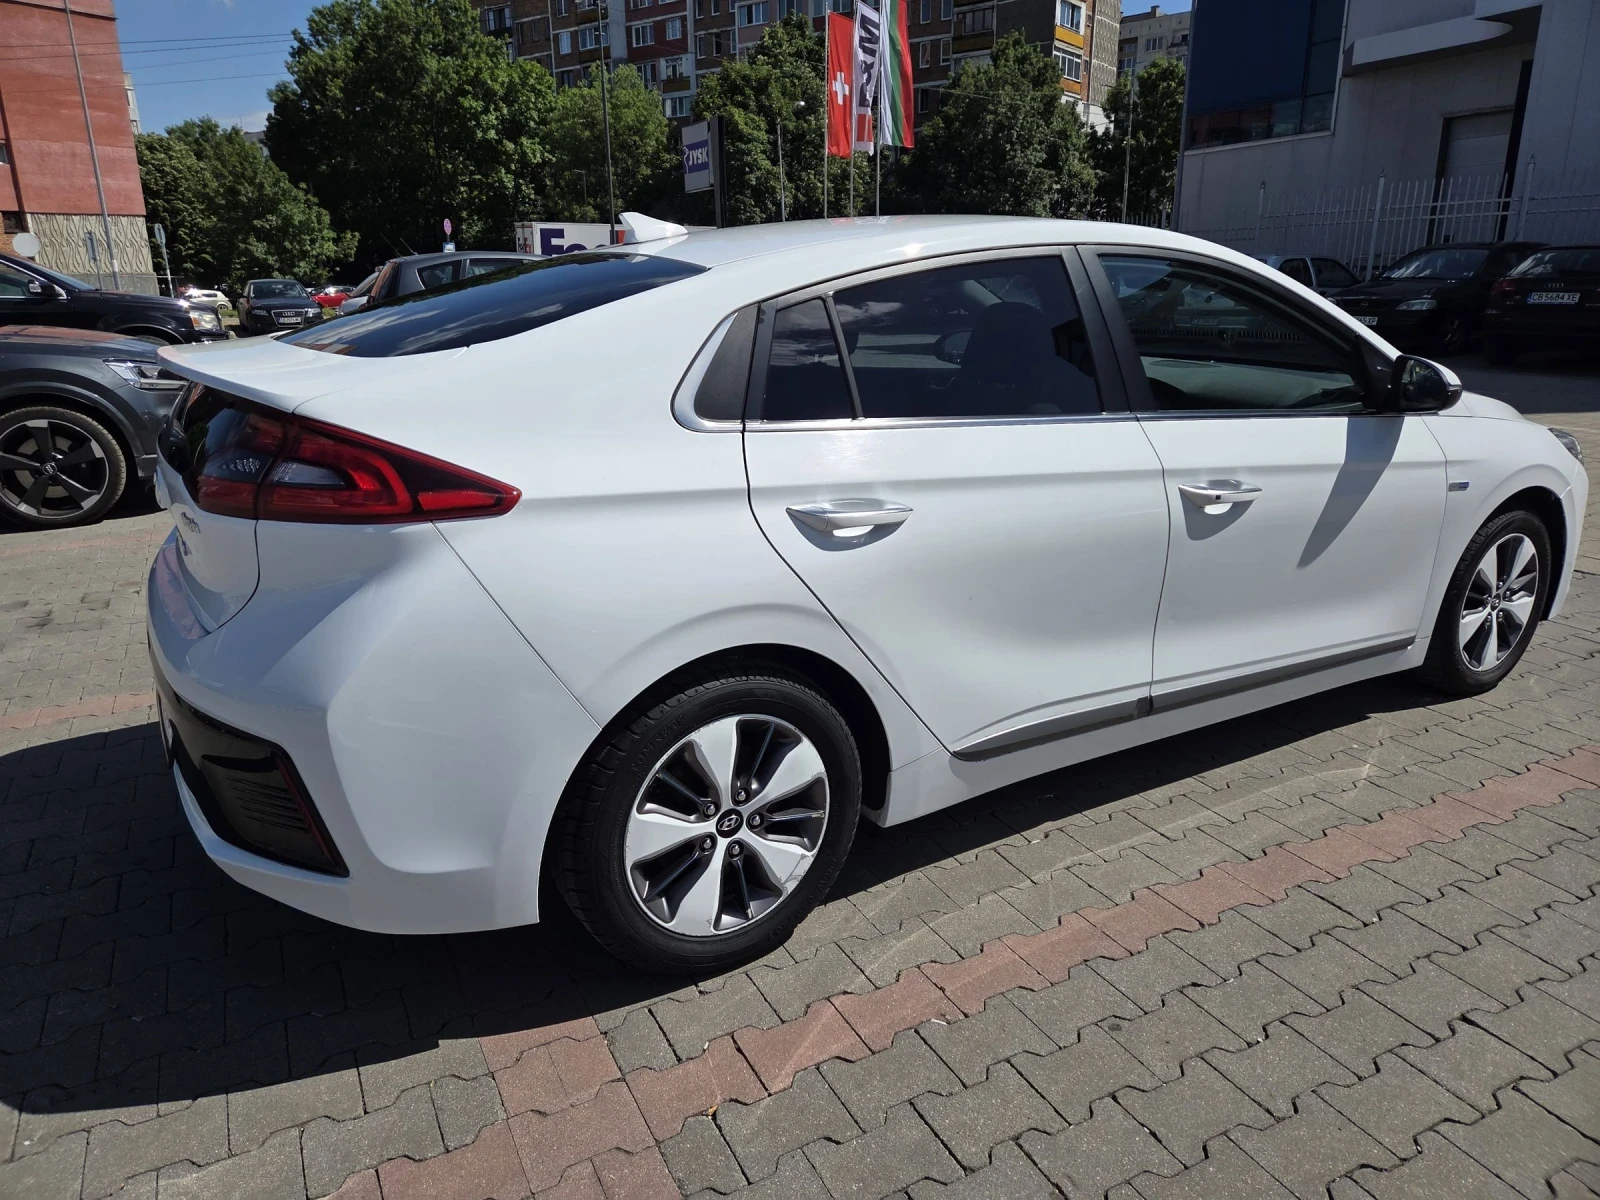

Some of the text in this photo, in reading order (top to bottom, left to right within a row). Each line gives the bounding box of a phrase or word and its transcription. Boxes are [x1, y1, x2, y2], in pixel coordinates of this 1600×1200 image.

[688, 146, 708, 166] JYSK
[1532, 293, 1579, 302] CB 5684 XE
